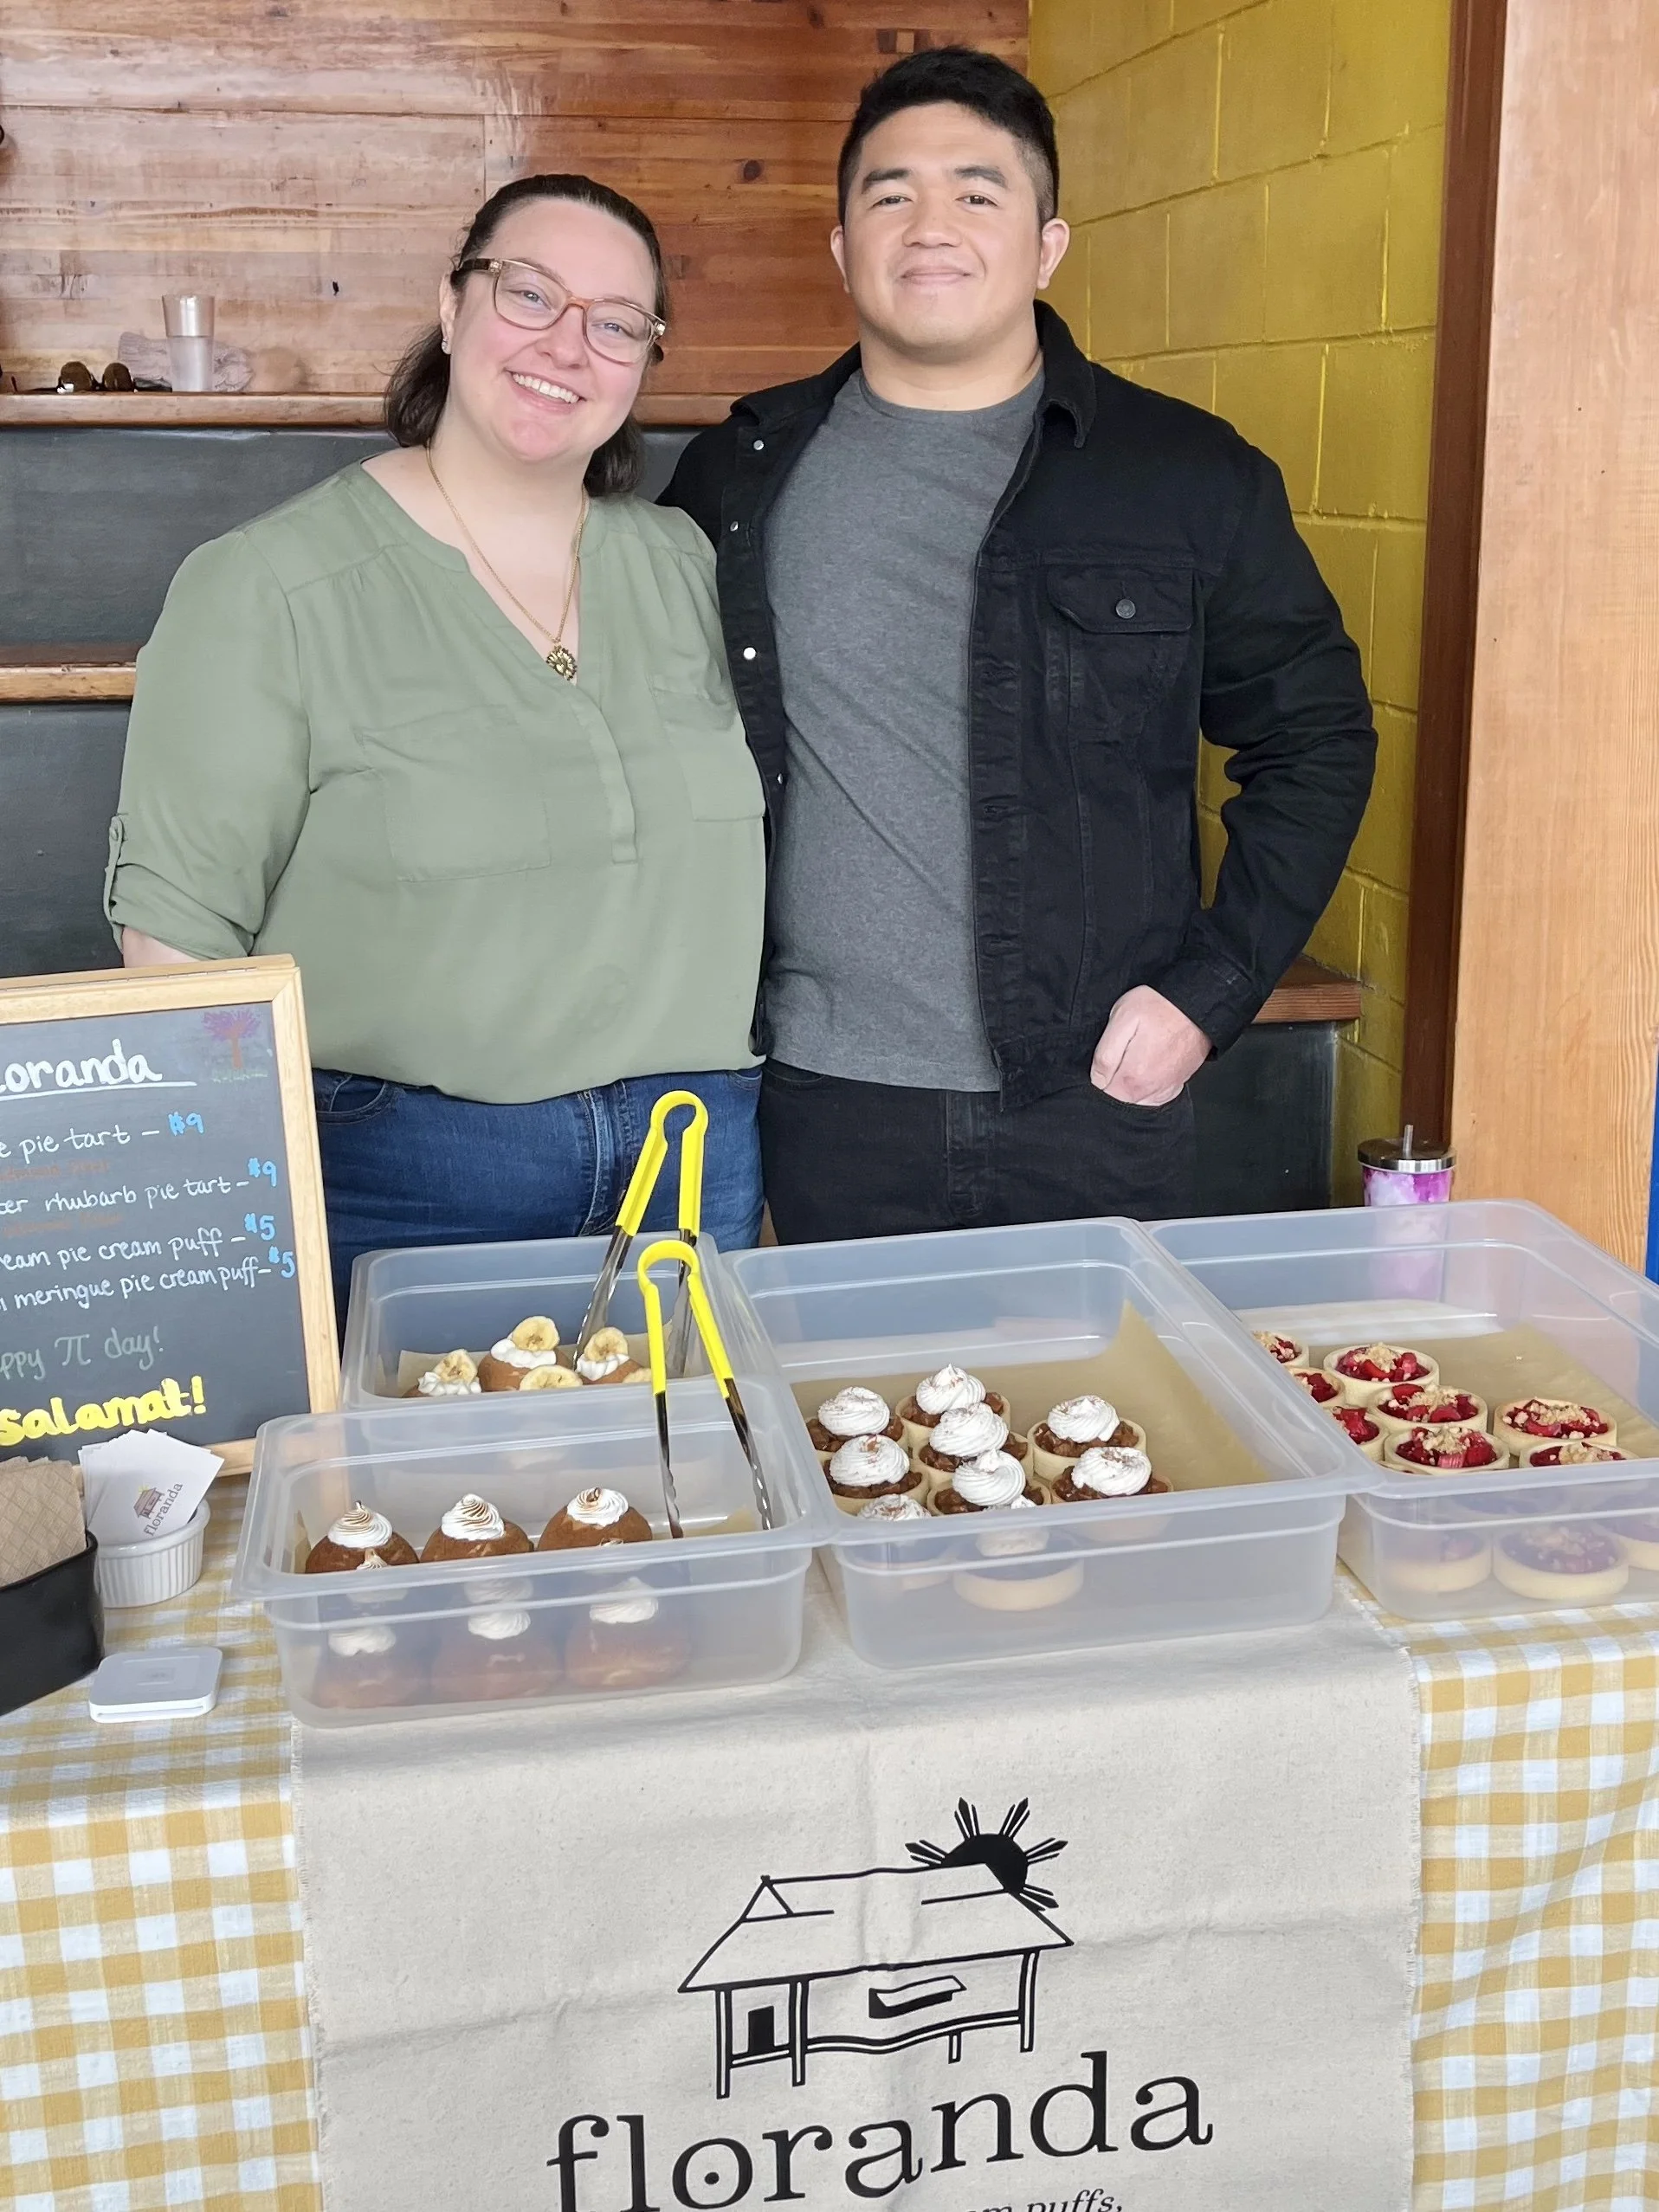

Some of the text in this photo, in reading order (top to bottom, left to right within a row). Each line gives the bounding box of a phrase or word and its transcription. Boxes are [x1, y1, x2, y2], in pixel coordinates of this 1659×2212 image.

[0, 1039, 163, 1093] oranda
[19, 1135, 59, 1164] pie
[63, 1125, 131, 1150] tart
[168, 1112, 203, 1136] $9
[45, 1185, 137, 1212] rhubarb
[144, 1183, 179, 1209] pie
[183, 1177, 231, 1193] tart
[248, 1158, 277, 1187] $9
[0, 1251, 51, 1271] eam
[57, 1247, 91, 1270] pie
[99, 1241, 162, 1260] cream
[168, 1227, 223, 1261] puff
[244, 1213, 275, 1241] $5
[14, 1279, 114, 1309] meringue
[119, 1274, 154, 1299] pie
[159, 1268, 217, 1289] cream
[268, 1246, 295, 1278] $5
[105, 1326, 164, 1370] day!
[144, 1483, 183, 1536] floranda
[546, 2051, 1212, 2212] floranda
